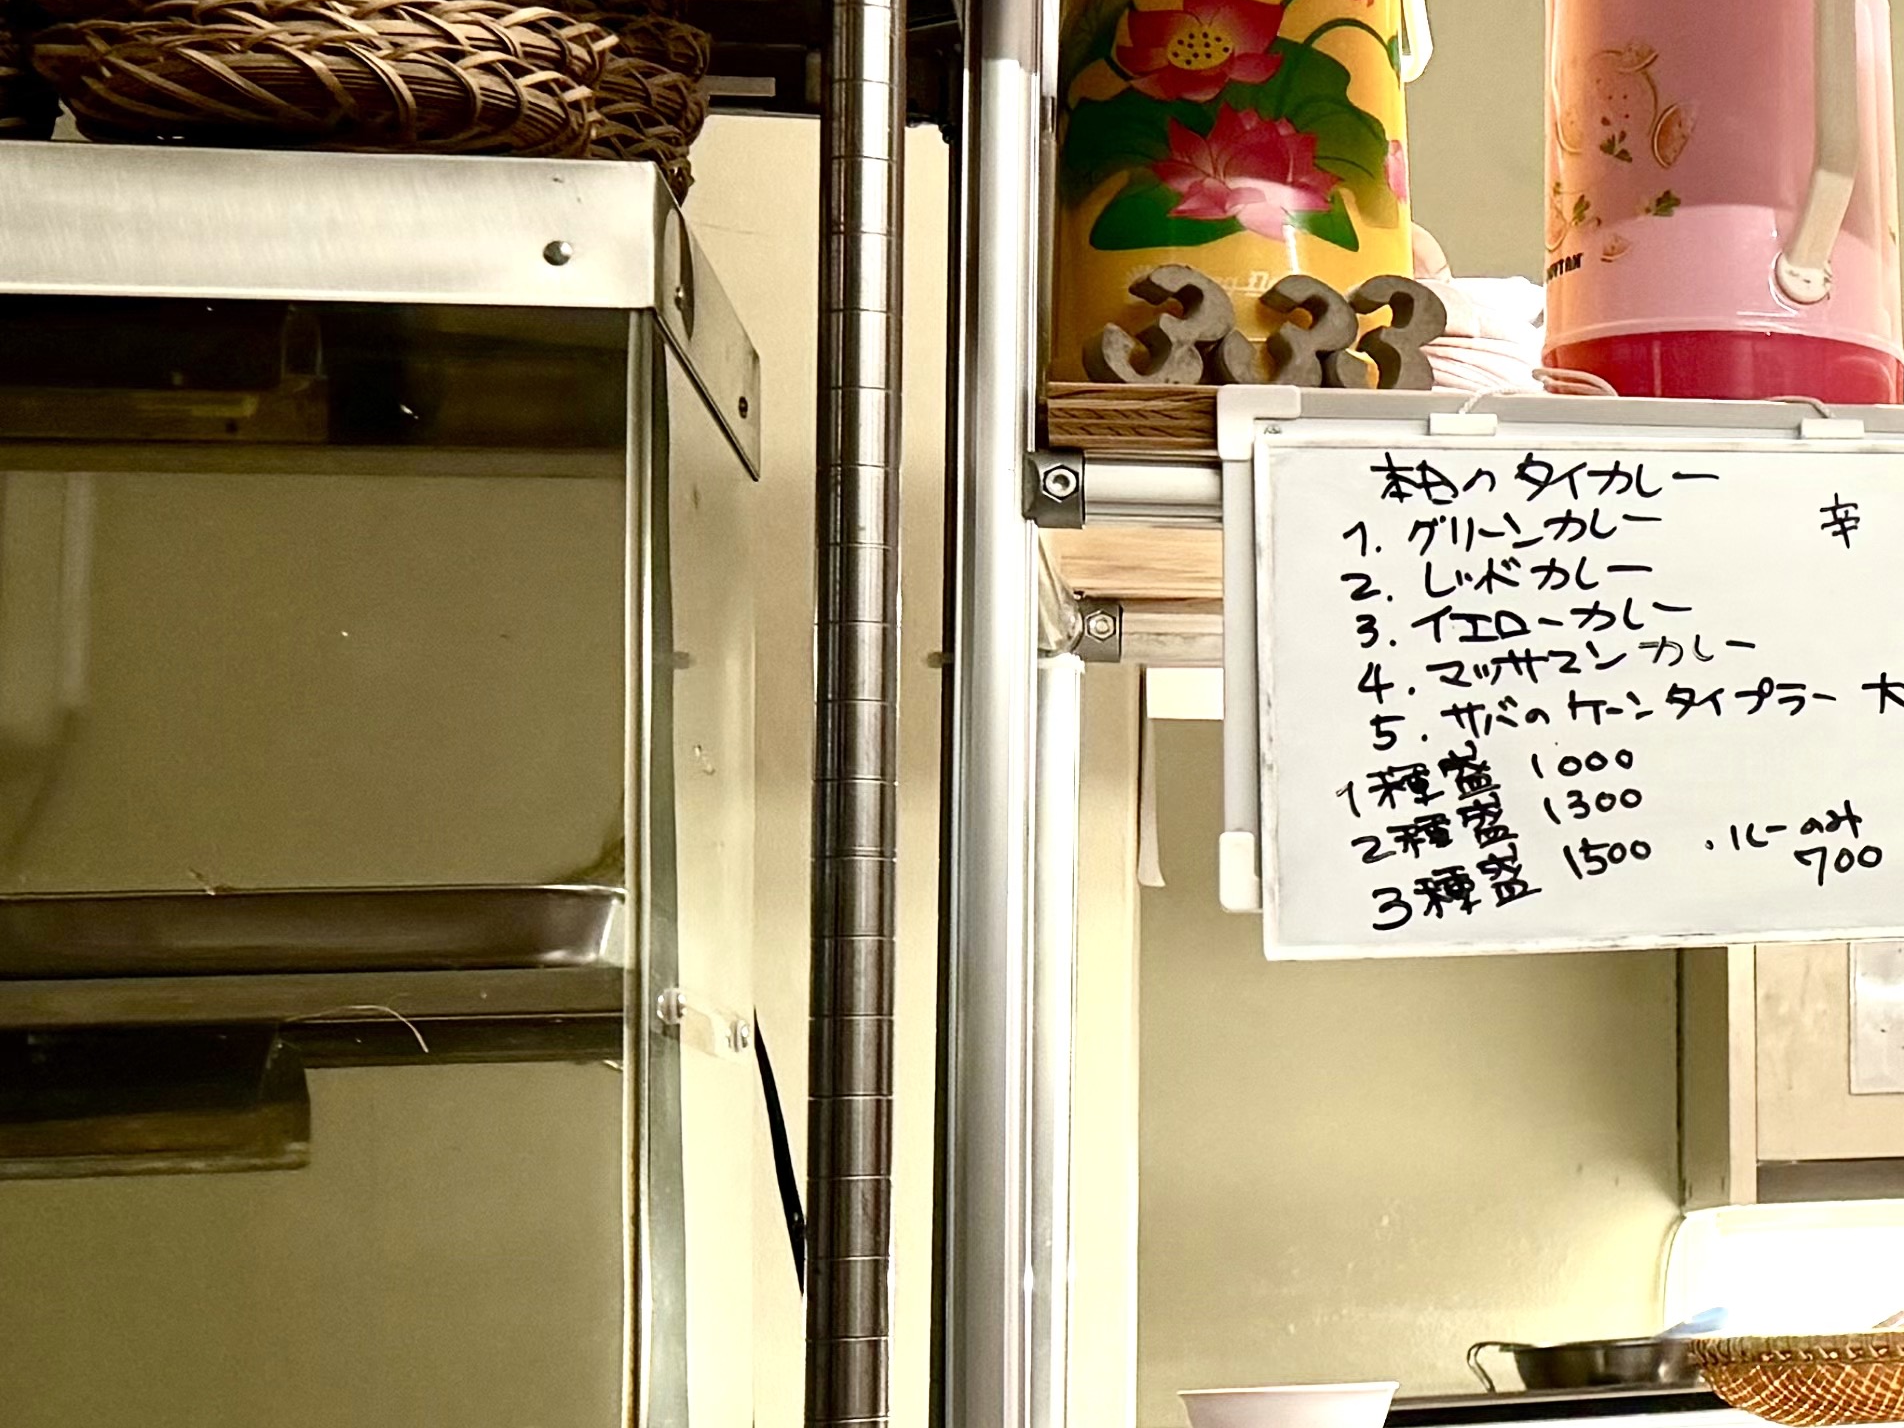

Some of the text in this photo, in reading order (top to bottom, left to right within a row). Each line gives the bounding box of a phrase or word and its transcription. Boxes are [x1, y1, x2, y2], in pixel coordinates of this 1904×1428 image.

[1408, 508, 1661, 556] グリーンカレー
[1341, 573, 1392, 601] 2.
[1356, 598, 1692, 648] 3. イエローカレー
[1358, 662, 1415, 704] 4.
[1532, 749, 1633, 778] 1000
[1544, 789, 1642, 824] 1300
[1563, 838, 1651, 879] 1500
[1794, 846, 1882, 886] 700
